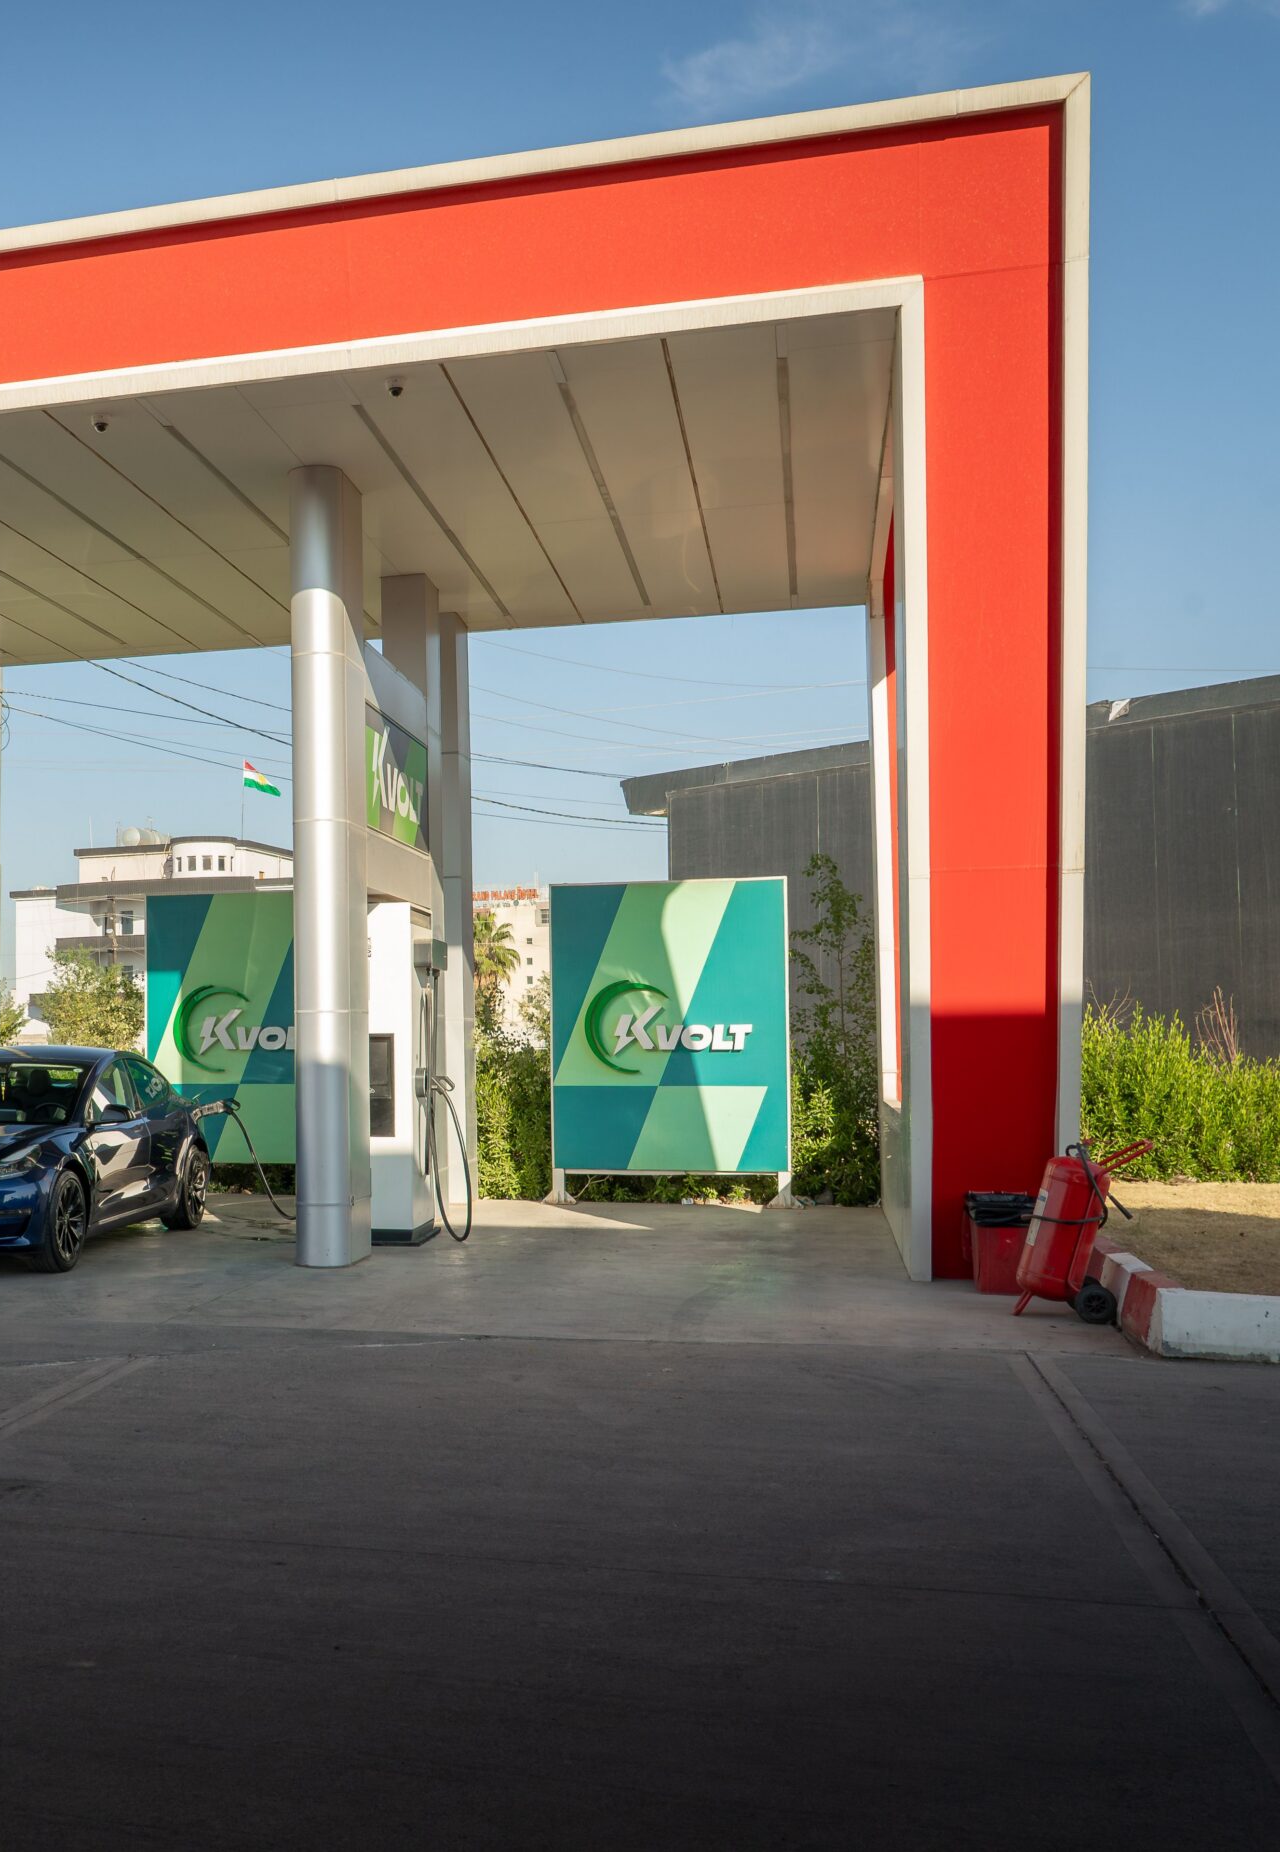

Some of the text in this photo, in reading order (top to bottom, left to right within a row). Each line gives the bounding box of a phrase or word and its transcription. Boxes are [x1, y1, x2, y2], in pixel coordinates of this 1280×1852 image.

[372, 725, 424, 824] KVOLT
[199, 1008, 295, 1056] KVOL
[612, 1005, 753, 1056] KVOLT
